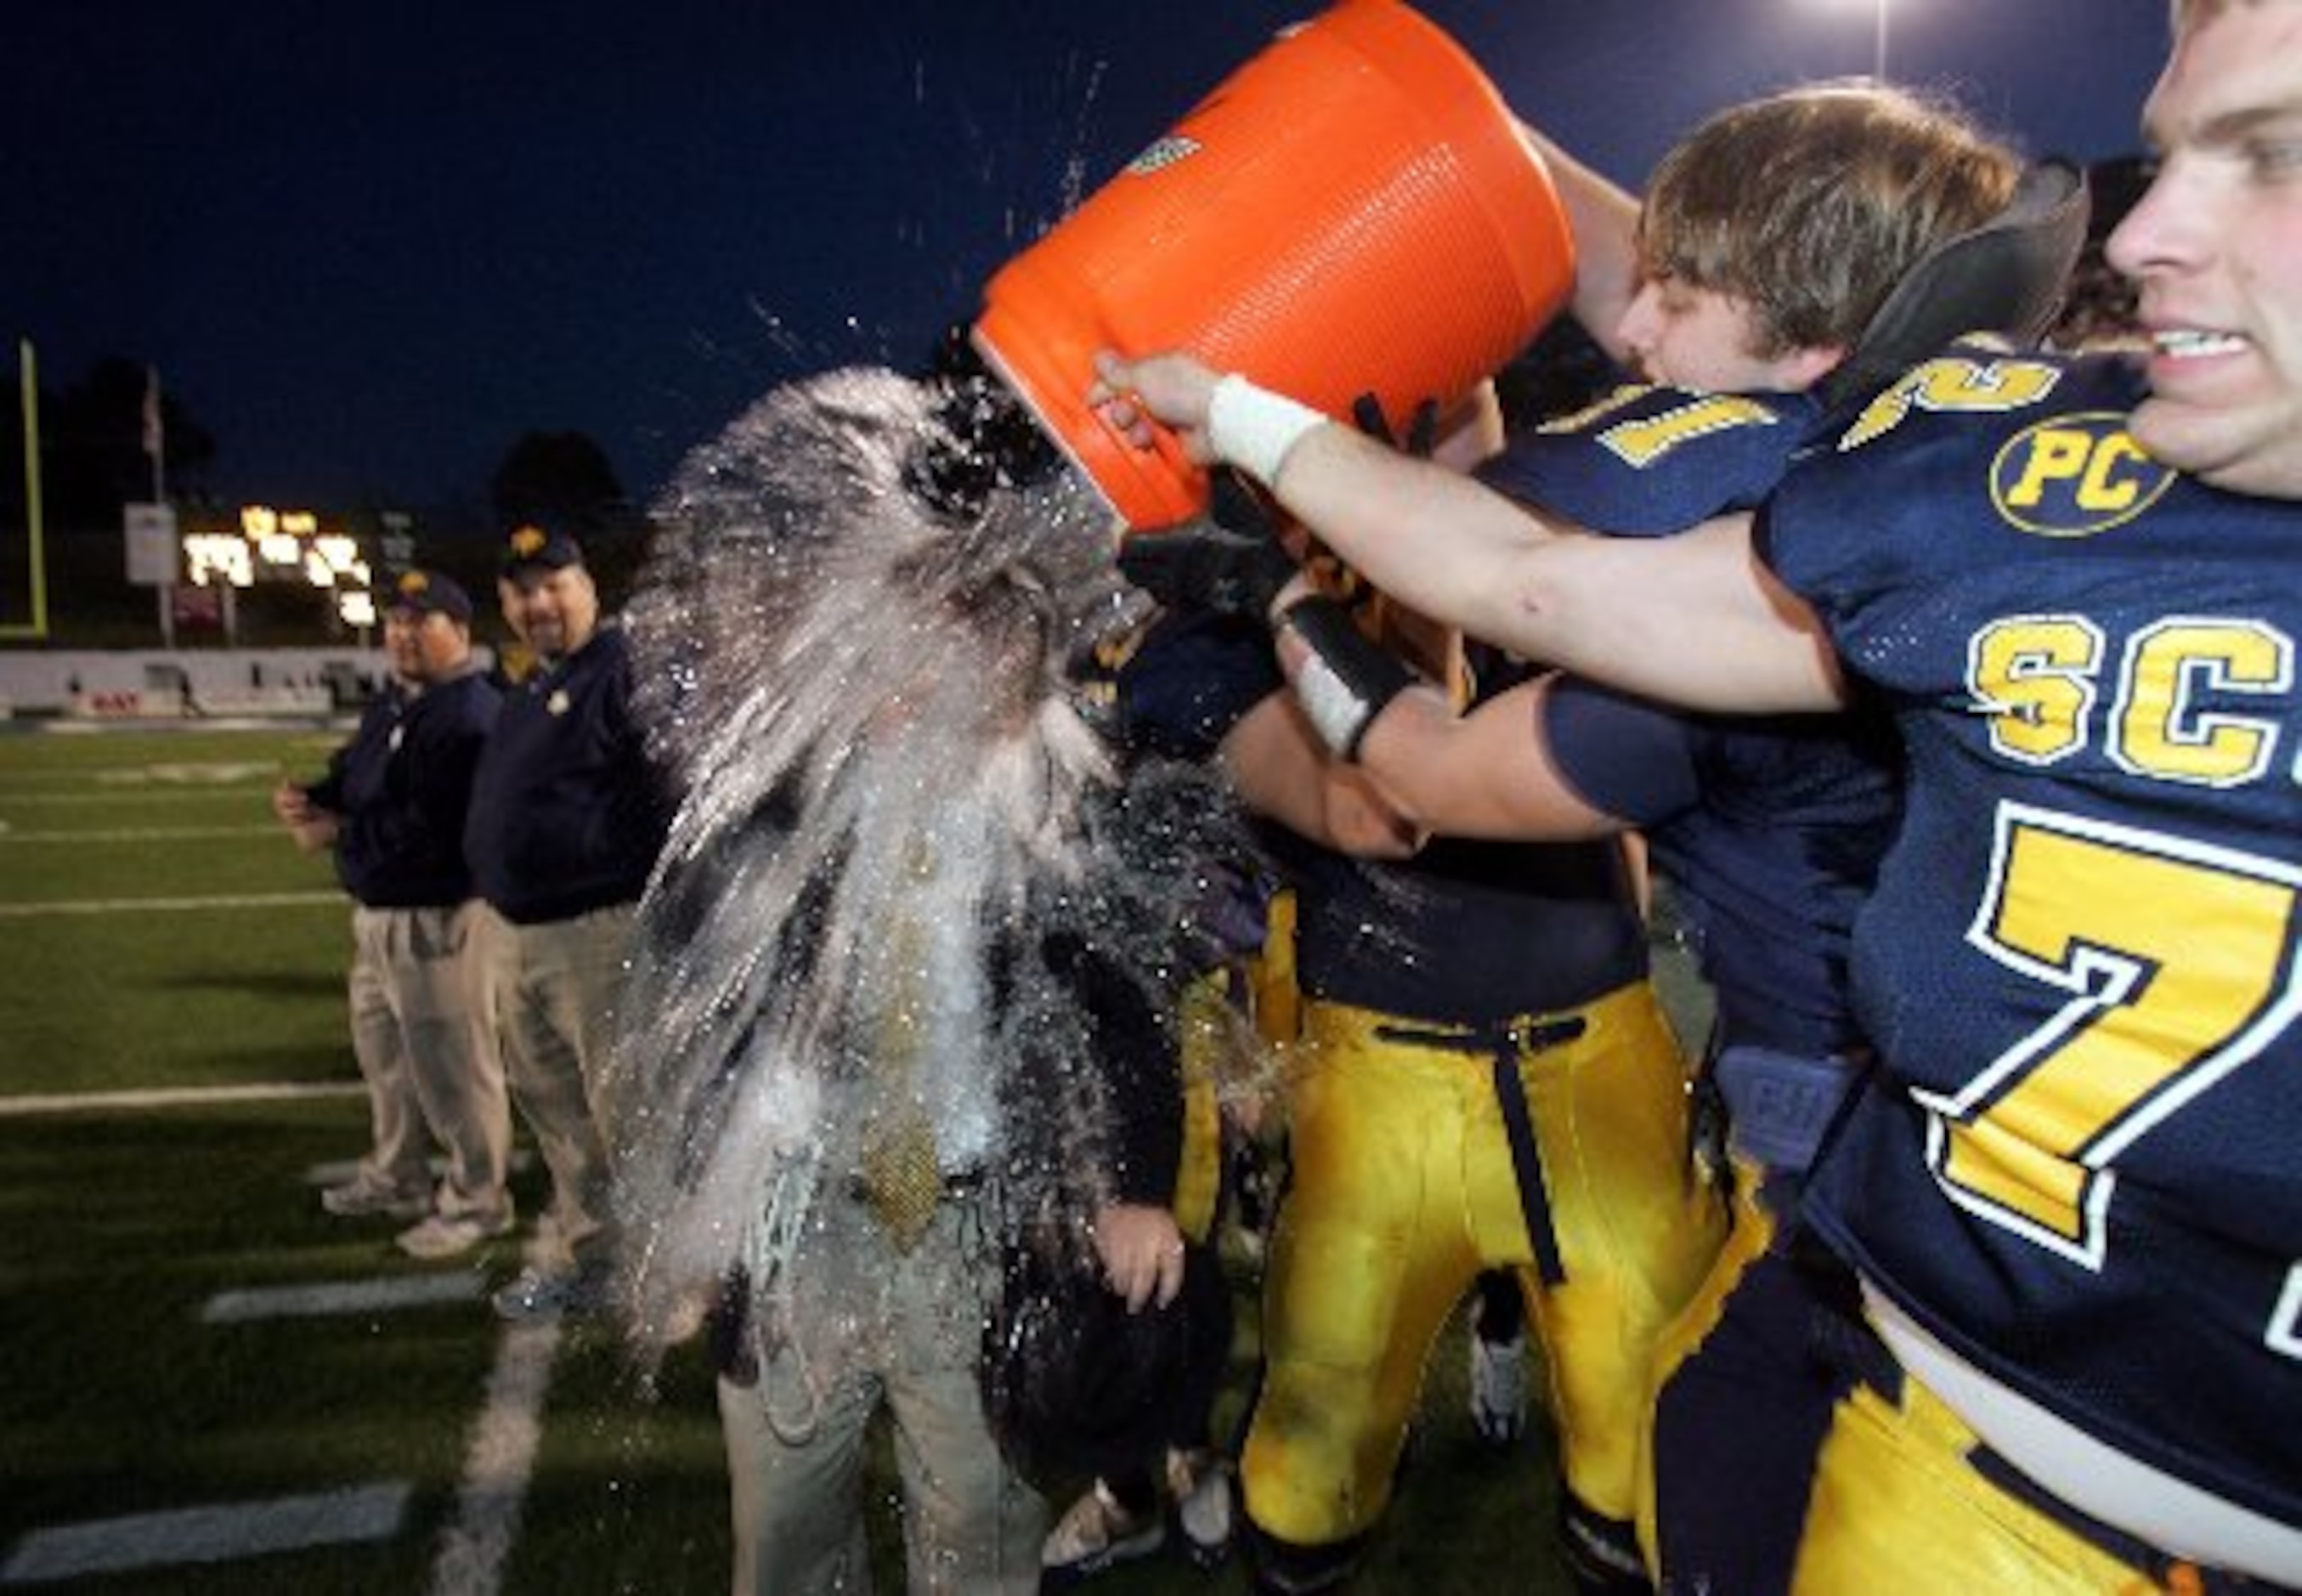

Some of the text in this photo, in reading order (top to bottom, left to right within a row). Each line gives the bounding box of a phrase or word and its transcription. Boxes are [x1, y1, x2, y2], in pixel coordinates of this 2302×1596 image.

[2005, 428, 2152, 510] PC
[1965, 613, 2302, 789] SC
[1909, 797, 2302, 1360] 7
